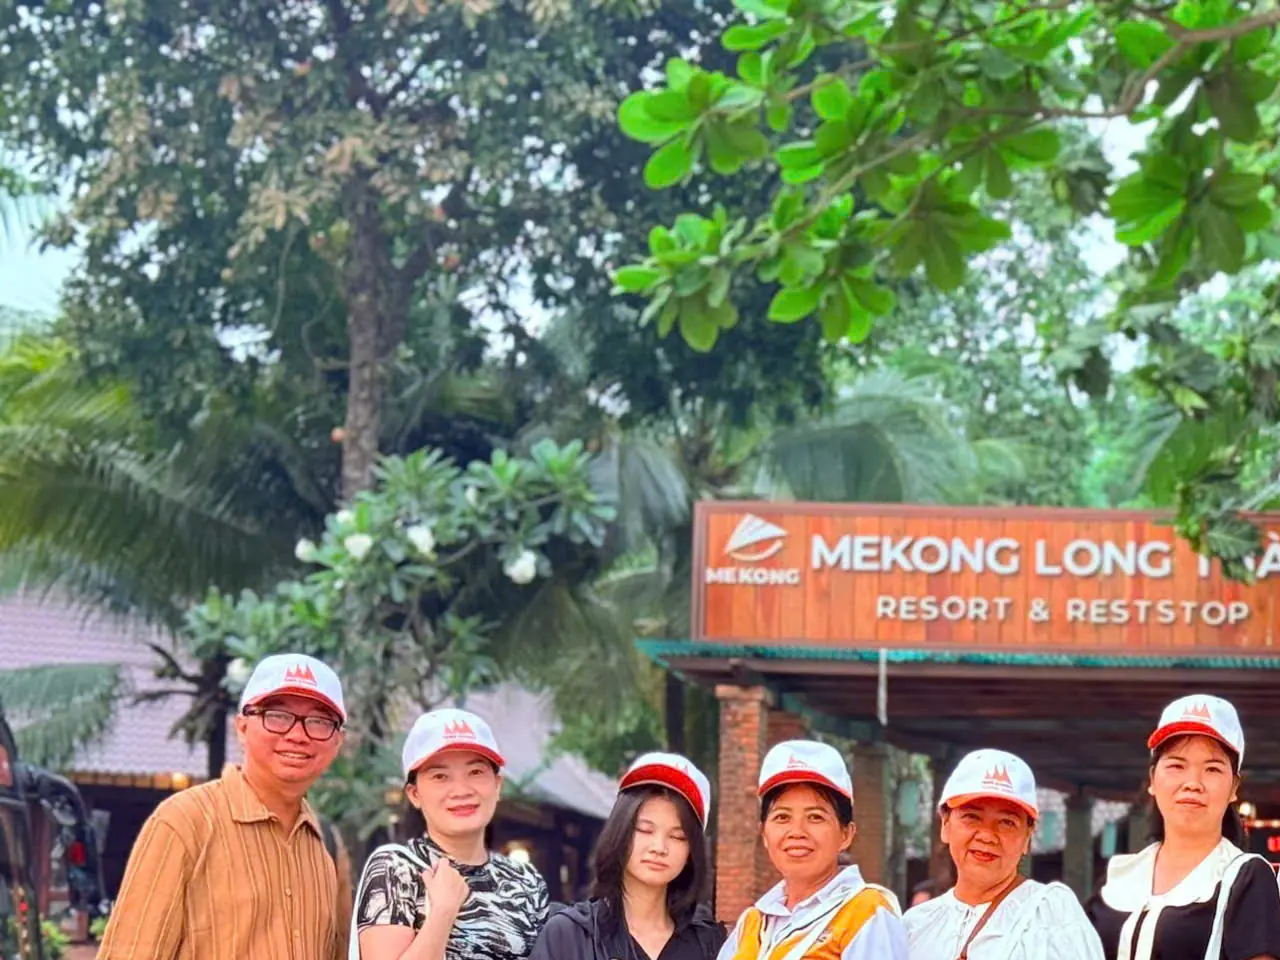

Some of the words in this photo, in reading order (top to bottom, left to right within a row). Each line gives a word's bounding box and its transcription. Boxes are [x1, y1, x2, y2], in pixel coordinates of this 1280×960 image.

[811, 533, 1020, 576] MEKONG
[1034, 538, 1172, 578] LONG
[705, 566, 801, 585] MEKONG
[875, 594, 1012, 622] RESORT
[1029, 598, 1051, 623] &
[1065, 598, 1250, 626] RESTSTOP
